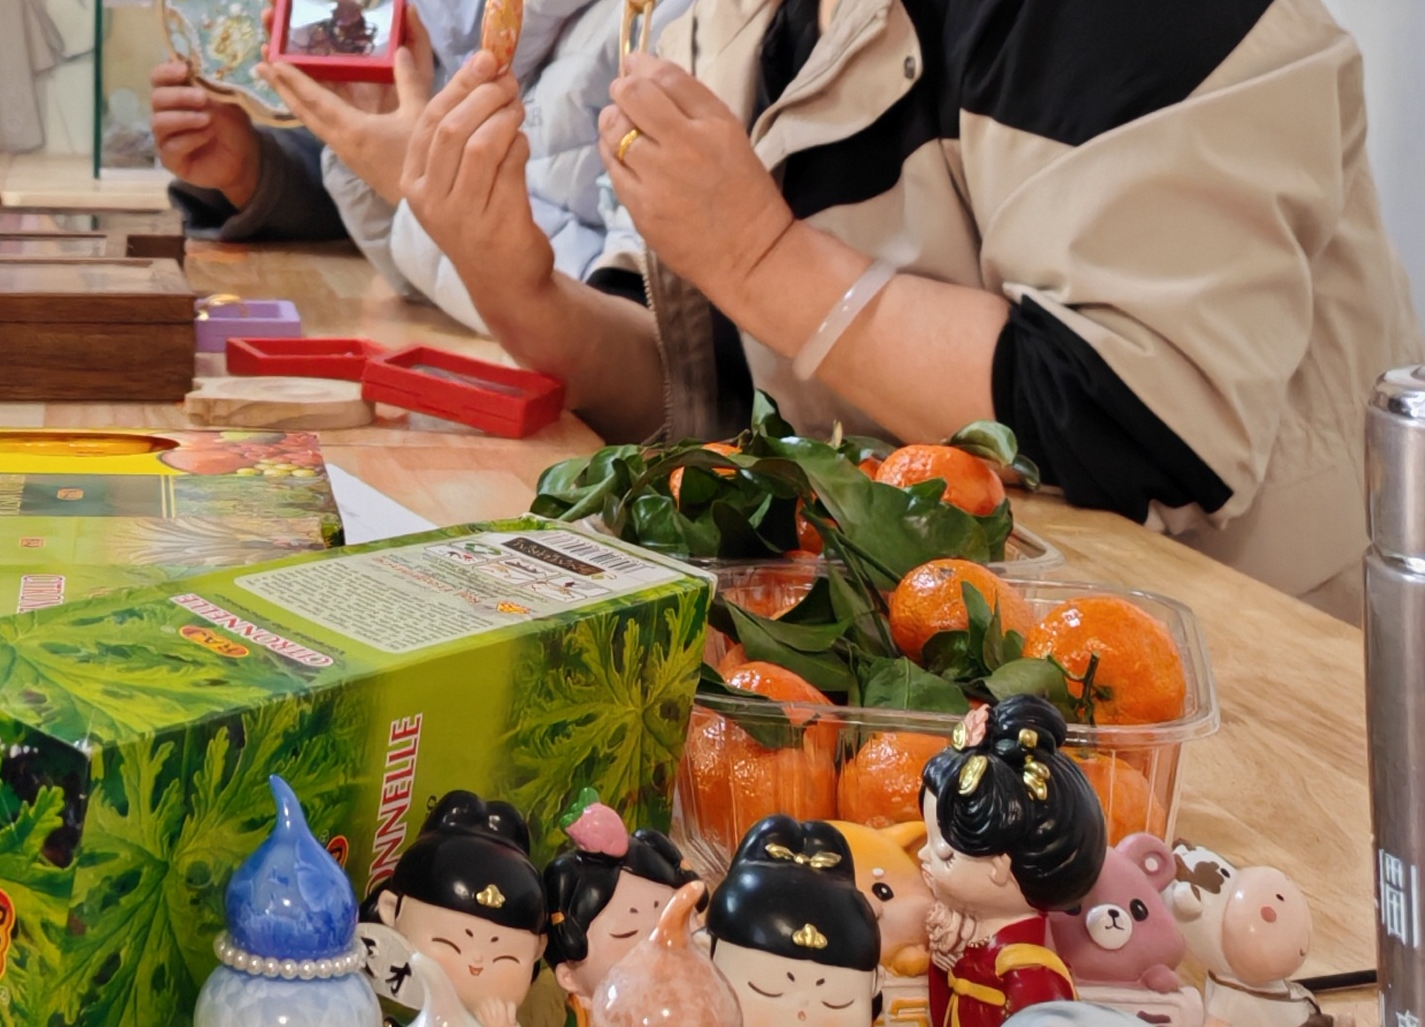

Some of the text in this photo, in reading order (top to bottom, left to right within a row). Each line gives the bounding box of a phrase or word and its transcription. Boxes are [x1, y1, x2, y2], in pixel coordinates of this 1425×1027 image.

[18, 575, 65, 613] CITRON
[171, 593, 334, 667] CITRONNELLE
[186, 626, 249, 656] RAJ
